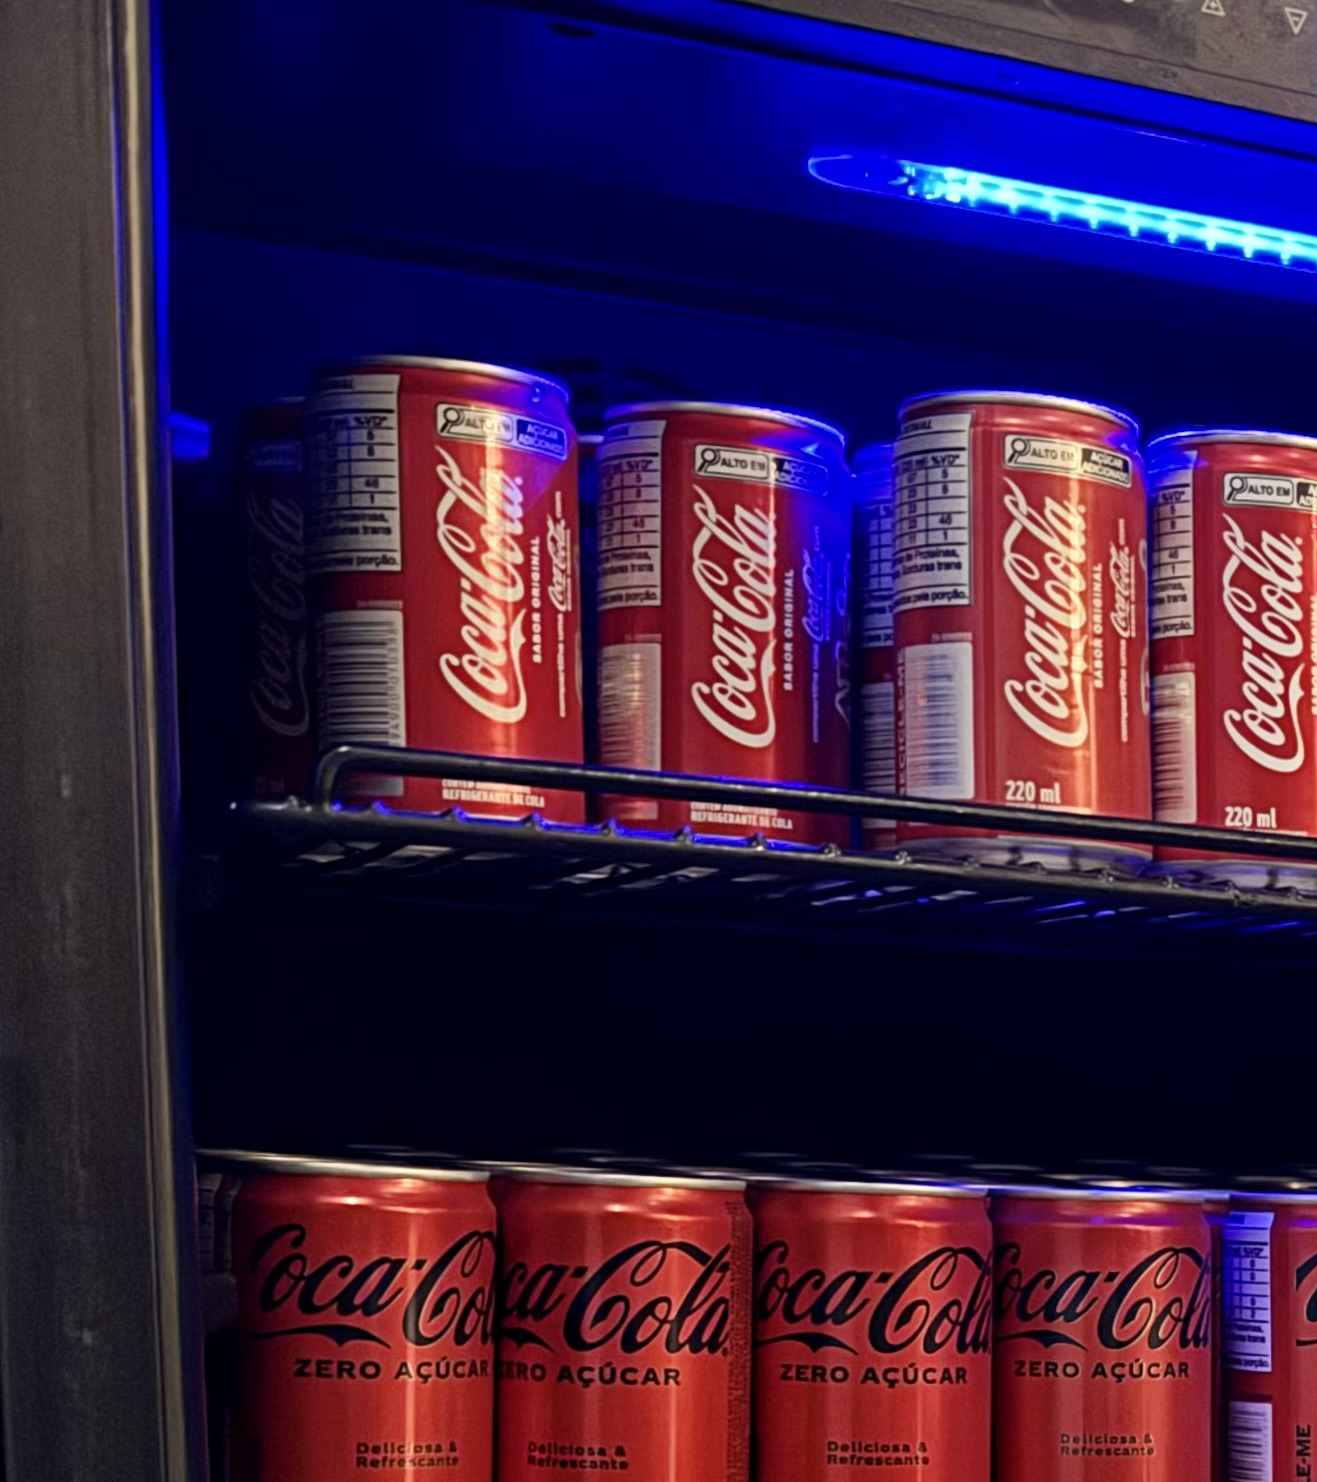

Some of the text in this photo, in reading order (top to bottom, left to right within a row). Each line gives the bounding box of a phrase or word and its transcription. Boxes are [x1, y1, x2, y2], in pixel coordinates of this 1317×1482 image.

[1030, 447, 1058, 459] ALTO
[1248, 486, 1290, 497] ALTO EM
[436, 446, 525, 725] Coca-Cola
[532, 536, 542, 663] SABOR ORIGINAL
[1003, 476, 1087, 748] Coca-Cola
[691, 484, 778, 749] Coca-Cola
[1094, 564, 1103, 688] SABOR ORIGINAL
[783, 569, 794, 691] SABOR ORIGINAL
[1222, 512, 1304, 772] Coca-Cola
[1005, 780, 1060, 804] 220 ml
[1225, 806, 1277, 829] 220 ml
[501, 1241, 731, 1357] ca-Cola
[294, 1356, 489, 1384] ZERO AÇÚCAR
[556, 1361, 681, 1389] AÇÚCAR
[779, 1362, 967, 1389] ZERO AÇÚCAR
[1013, 1357, 1190, 1383] ZERO AÇÚCAR
[356, 1442, 443, 1455] Deliciosa
[527, 1441, 607, 1457] Deliciosa
[827, 1441, 911, 1453] Deliciosa
[1060, 1433, 1136, 1445] Deliciosa
[1060, 1445, 1154, 1457] Refrescante
[356, 1455, 459, 1468] Refrescante
[527, 1456, 628, 1470] Refrescante
[827, 1454, 930, 1466] Refrescante
